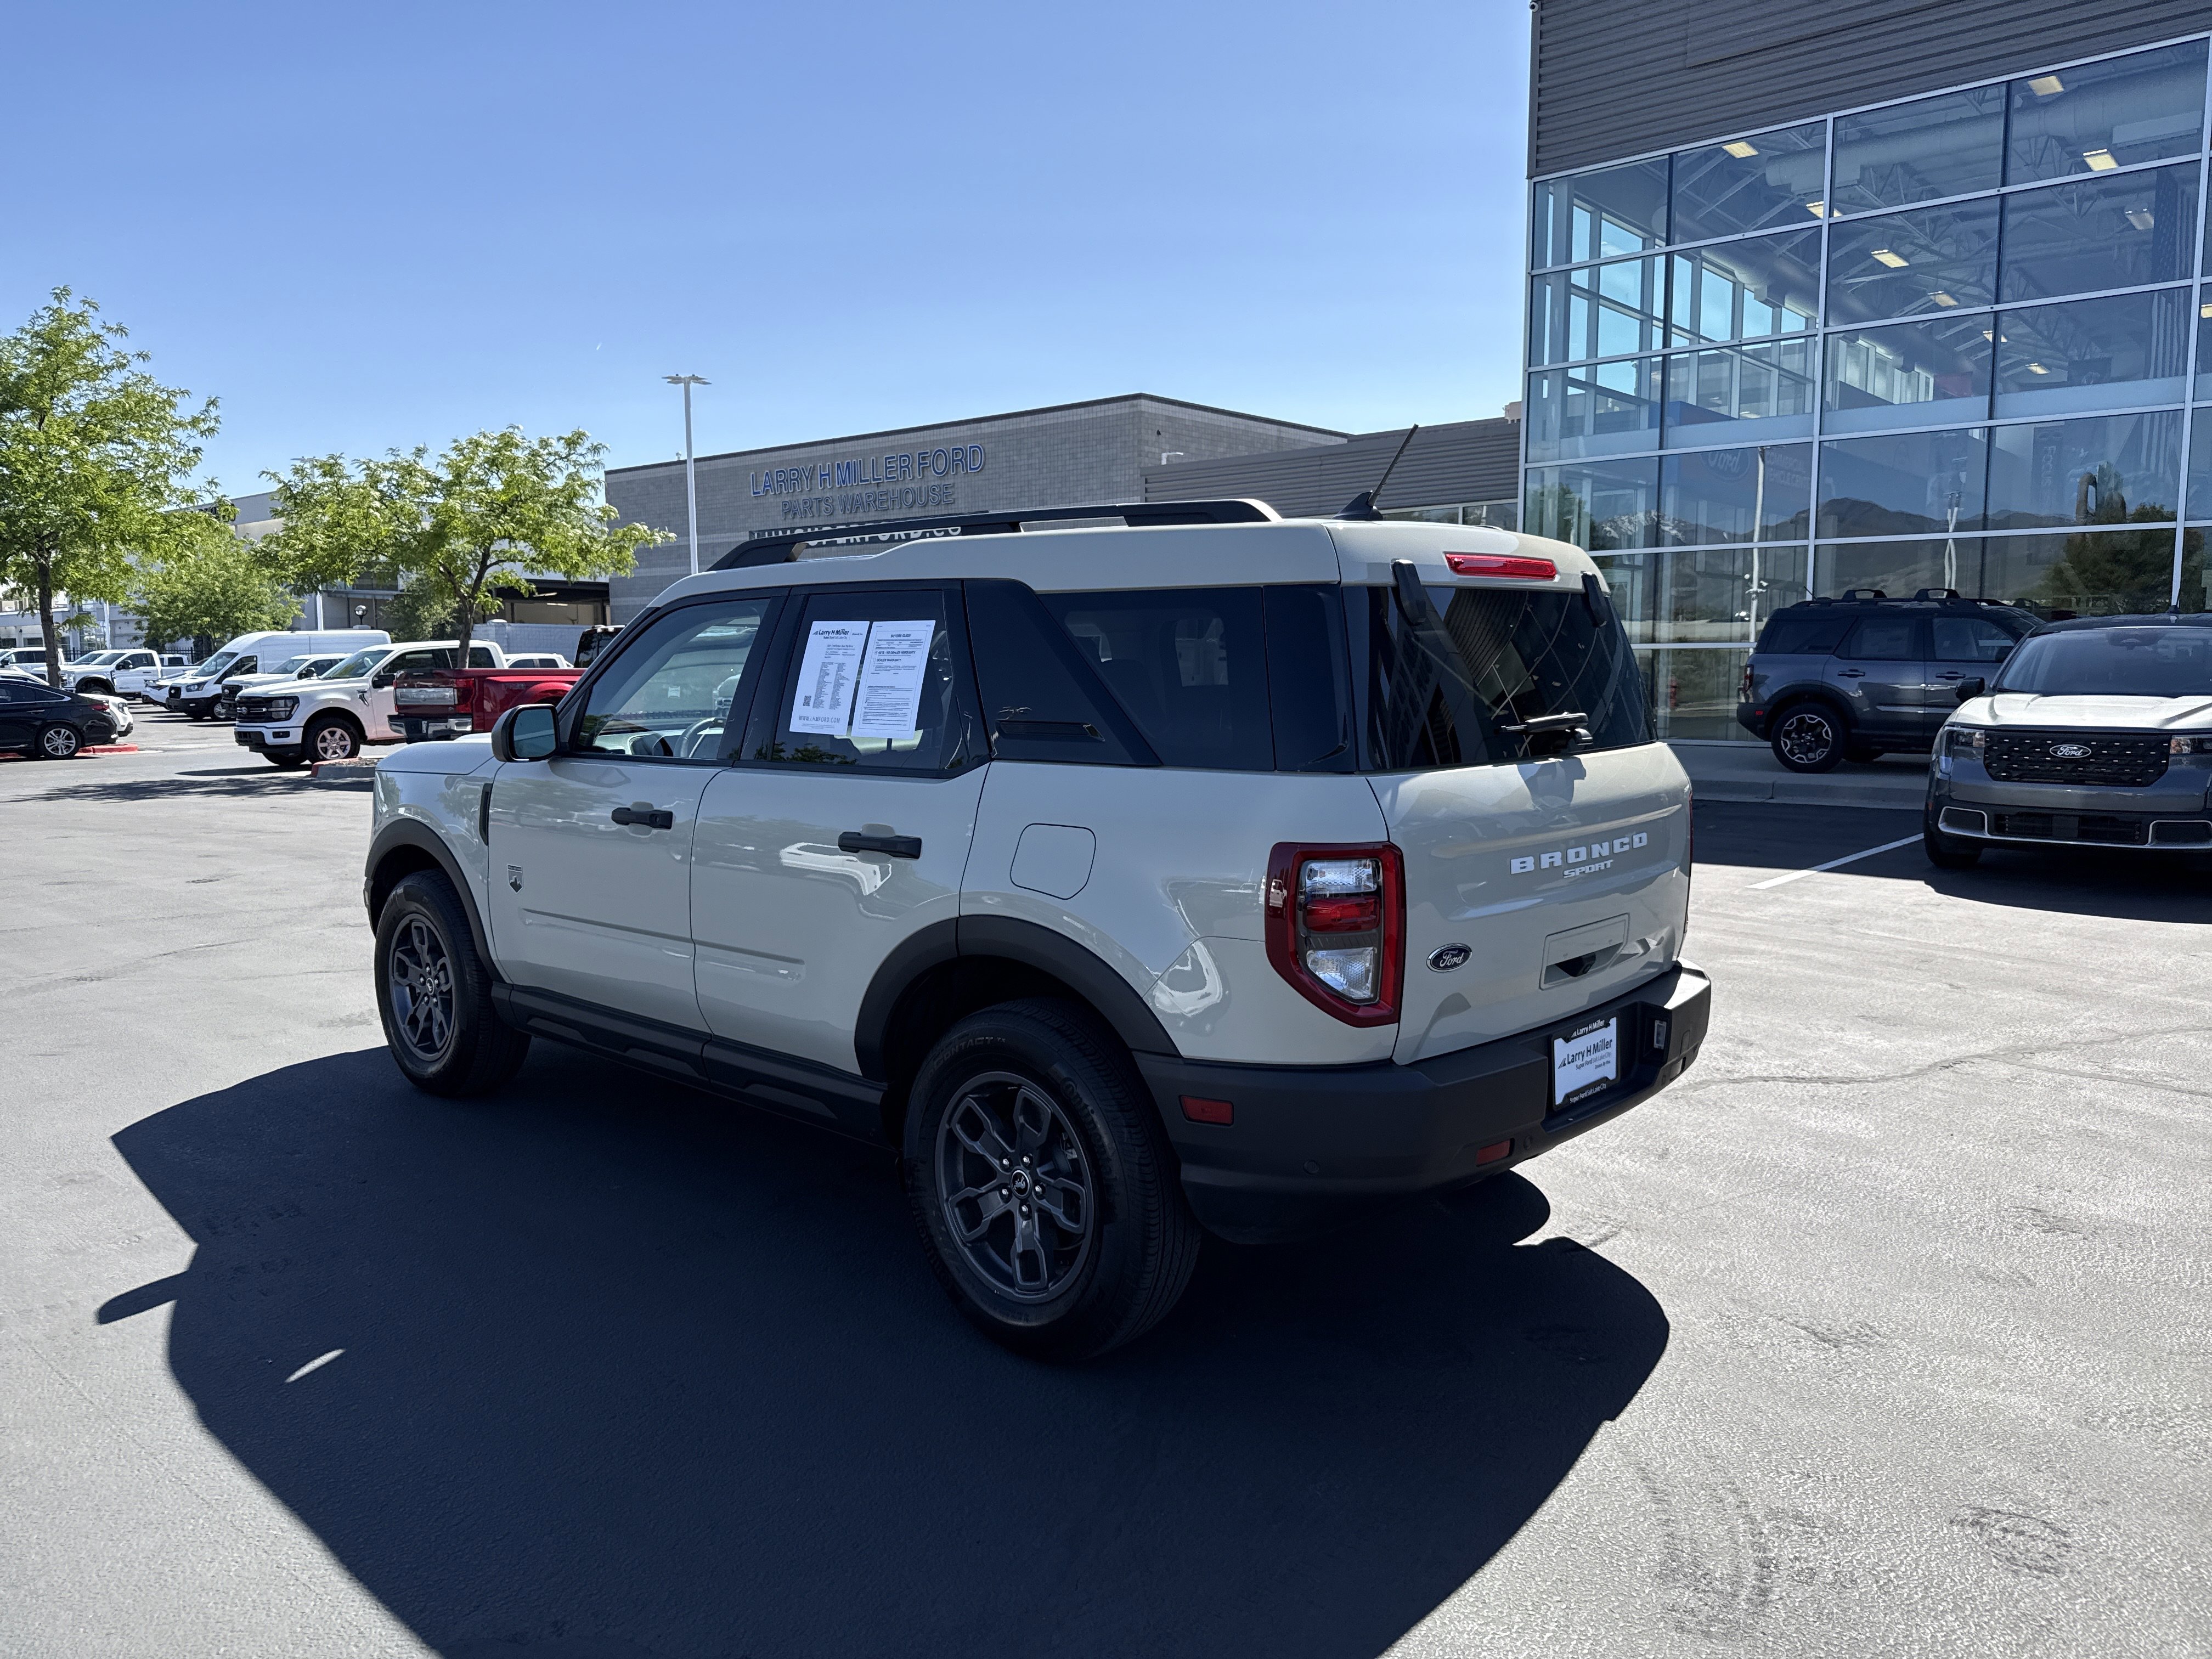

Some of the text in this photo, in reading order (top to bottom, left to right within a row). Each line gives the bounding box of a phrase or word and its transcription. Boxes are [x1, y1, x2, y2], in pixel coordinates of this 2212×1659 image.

[751, 444, 984, 496] LARRY H MILLER FORD
[782, 483, 953, 520] PARTS WAREHOUSE
[2057, 746, 2084, 756] Ford
[1510, 832, 1647, 875] BRONCO
[1563, 859, 1614, 878] SPORT
[1440, 950, 1464, 967] Ford
[1577, 1019, 1605, 1036] Larry H Miller
[1567, 1038, 1612, 1065] Larry H Miller
